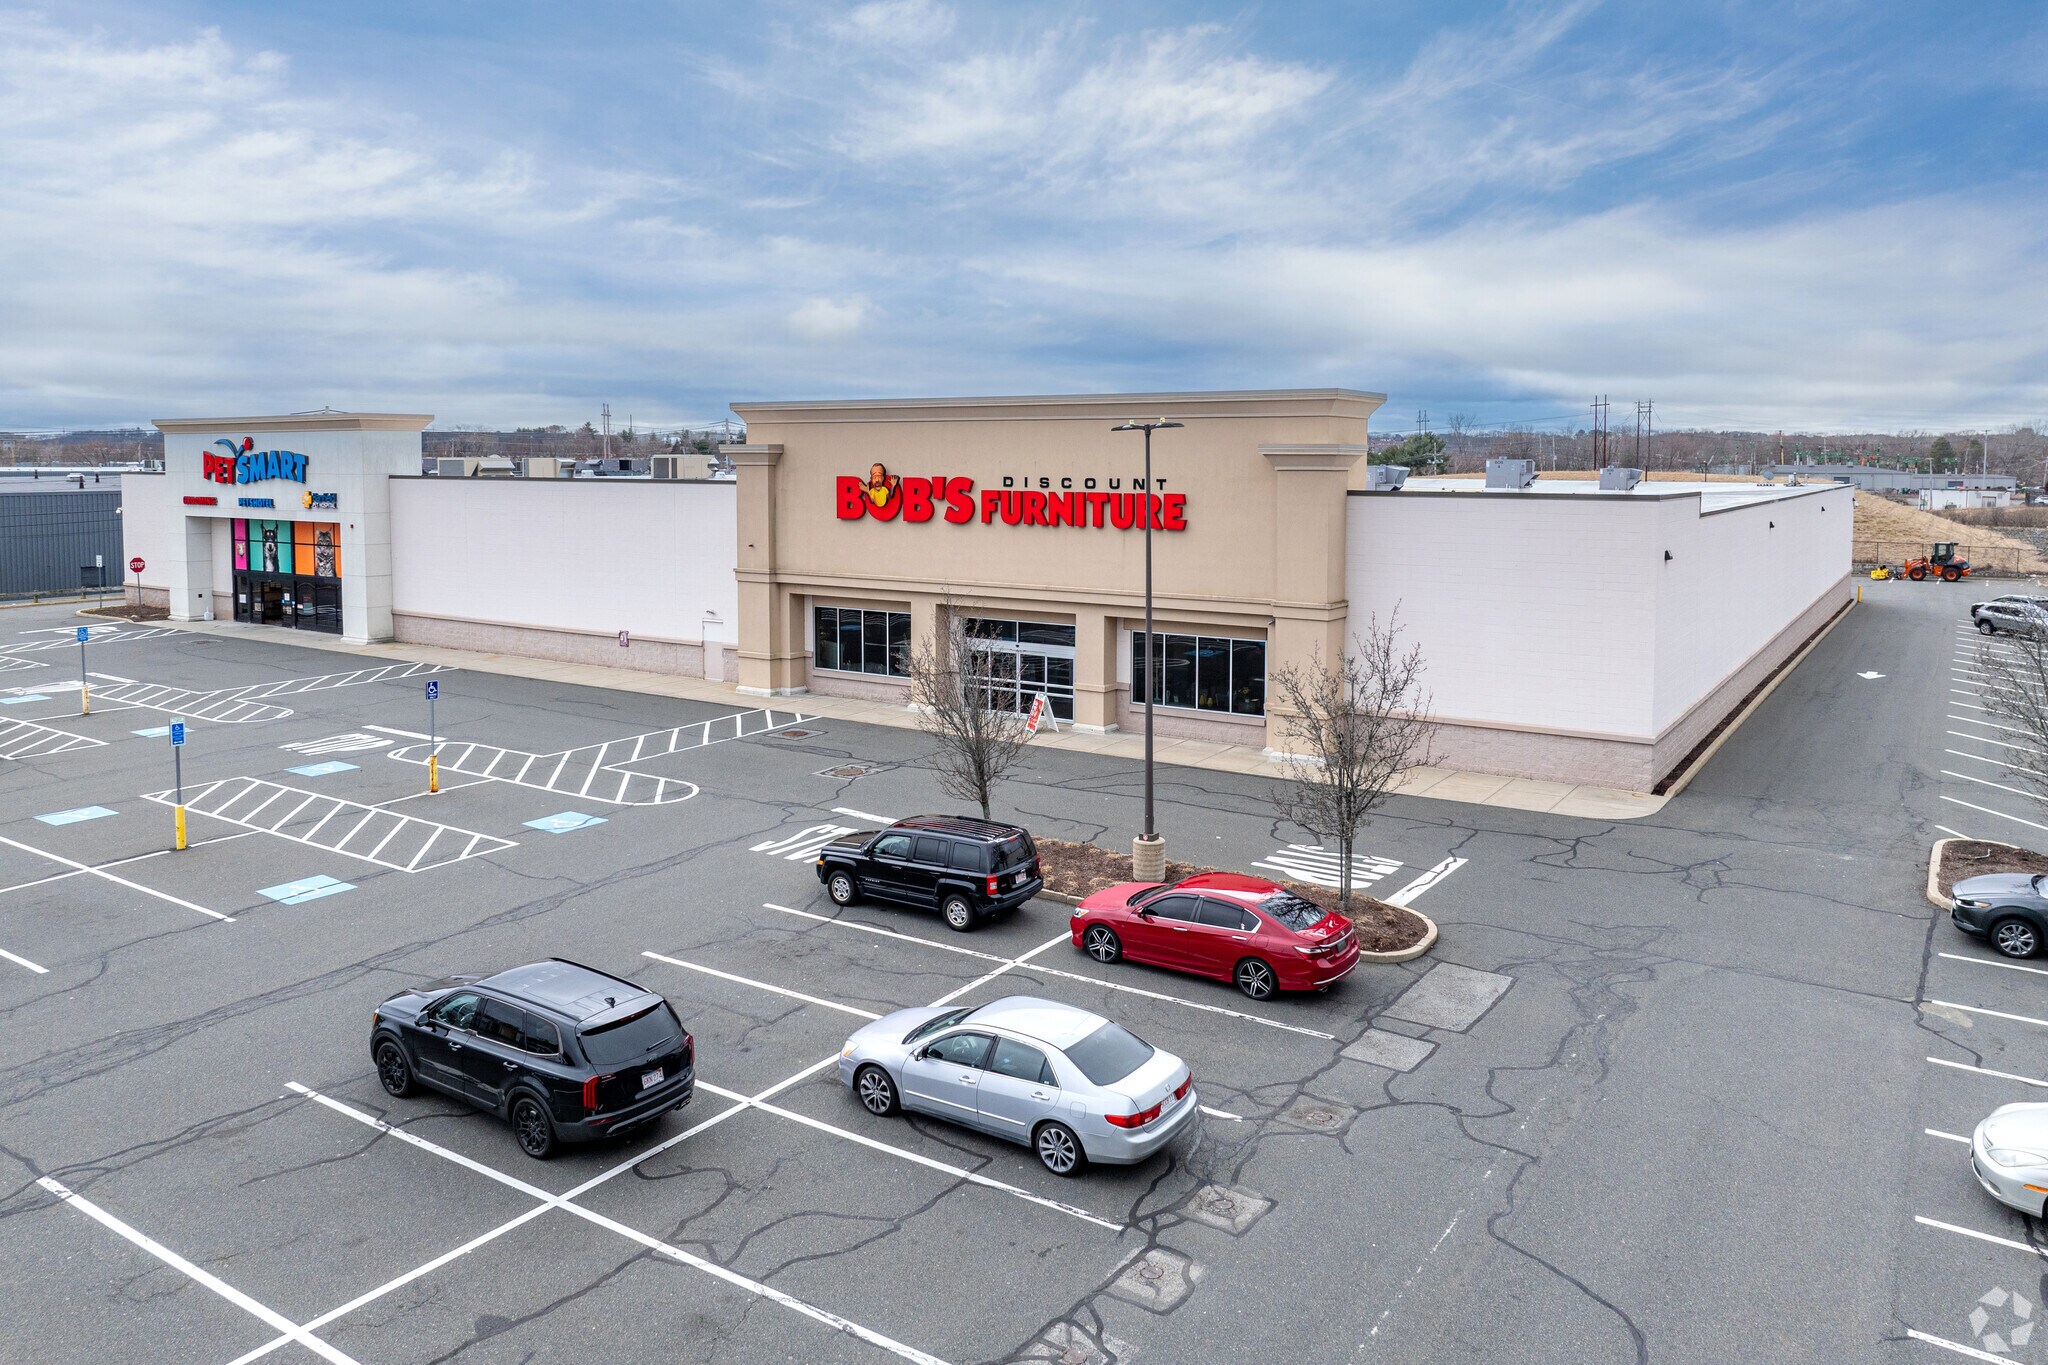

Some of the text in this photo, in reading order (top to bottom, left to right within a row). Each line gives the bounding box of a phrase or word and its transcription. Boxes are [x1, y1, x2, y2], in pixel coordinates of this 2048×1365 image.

[203, 450, 309, 484] PETSMART
[1003, 476, 1167, 490] DISCOUNT
[238, 498, 274, 508] PETSHOTEL
[836, 475, 1187, 530] BOB'S FURNITURE
